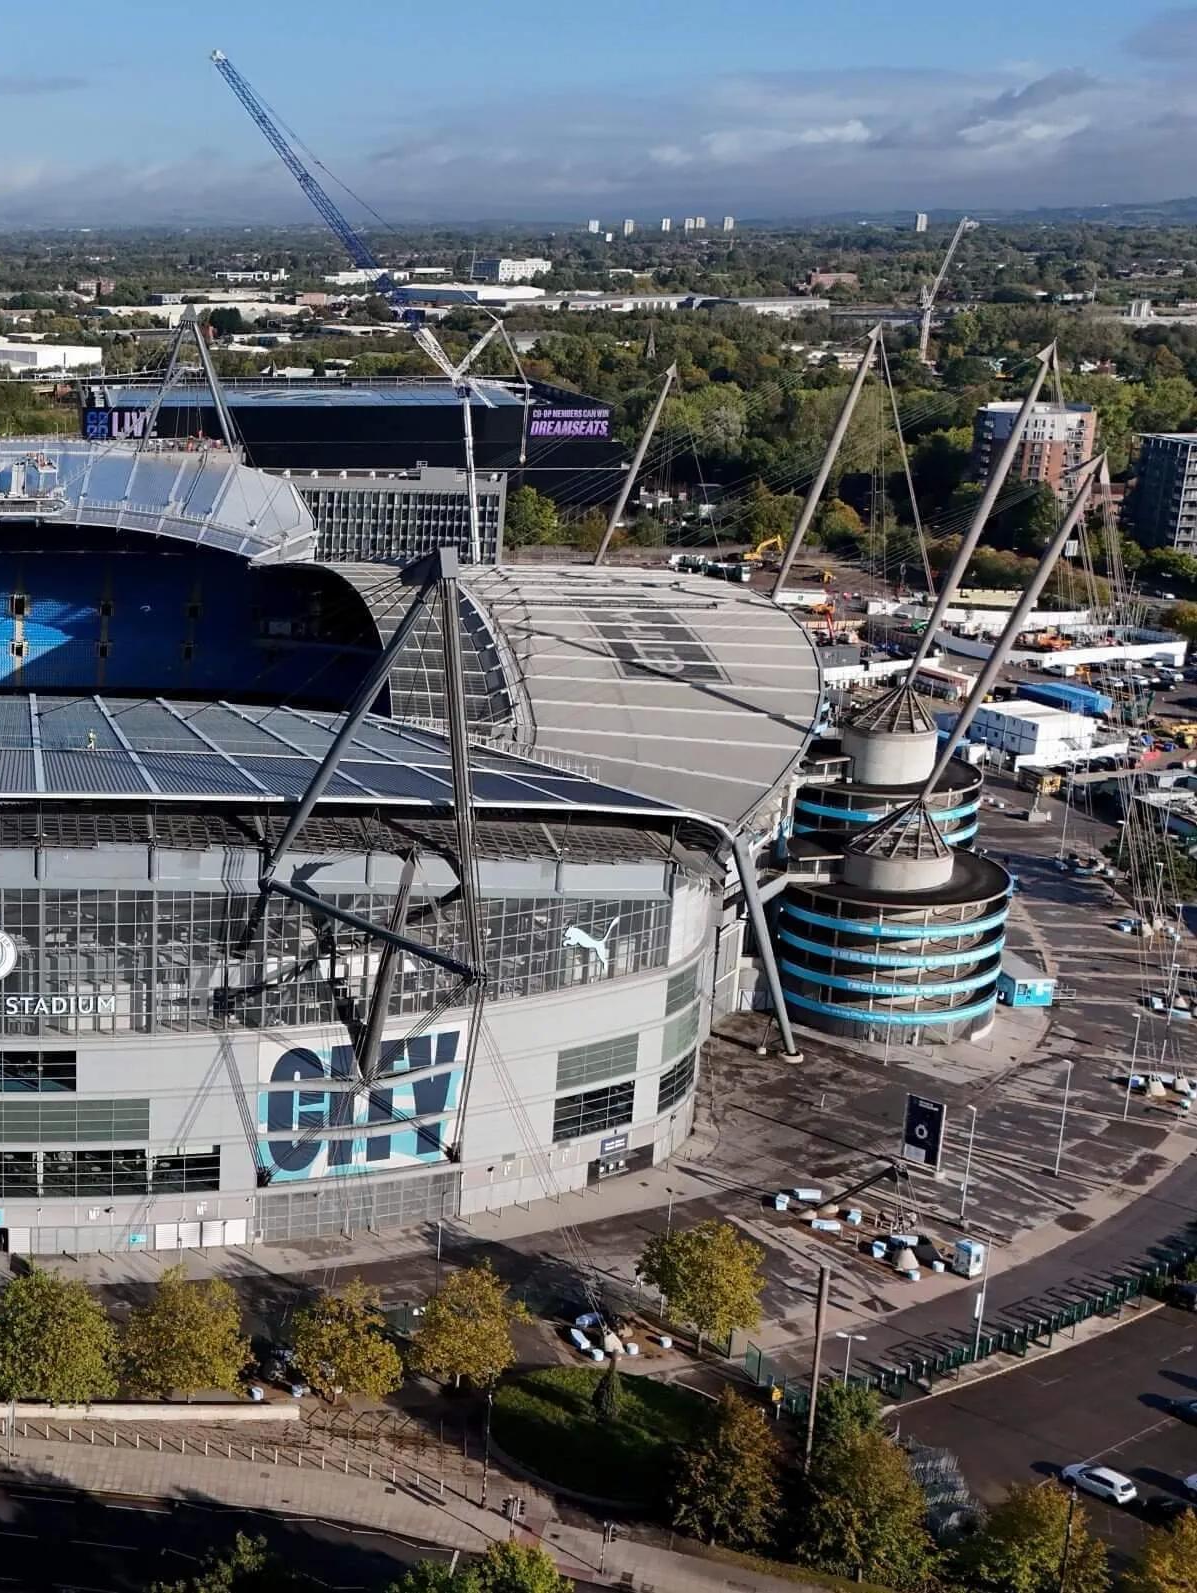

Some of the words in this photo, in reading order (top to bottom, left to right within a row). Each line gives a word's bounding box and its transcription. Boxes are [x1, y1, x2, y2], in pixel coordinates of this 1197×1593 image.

[552, 409, 583, 418] MEMBERS
[583, 409, 597, 418] CAN
[597, 409, 610, 418] WIN
[6, 995, 116, 1015] STADIUM
[267, 1031, 460, 1172] CITY
